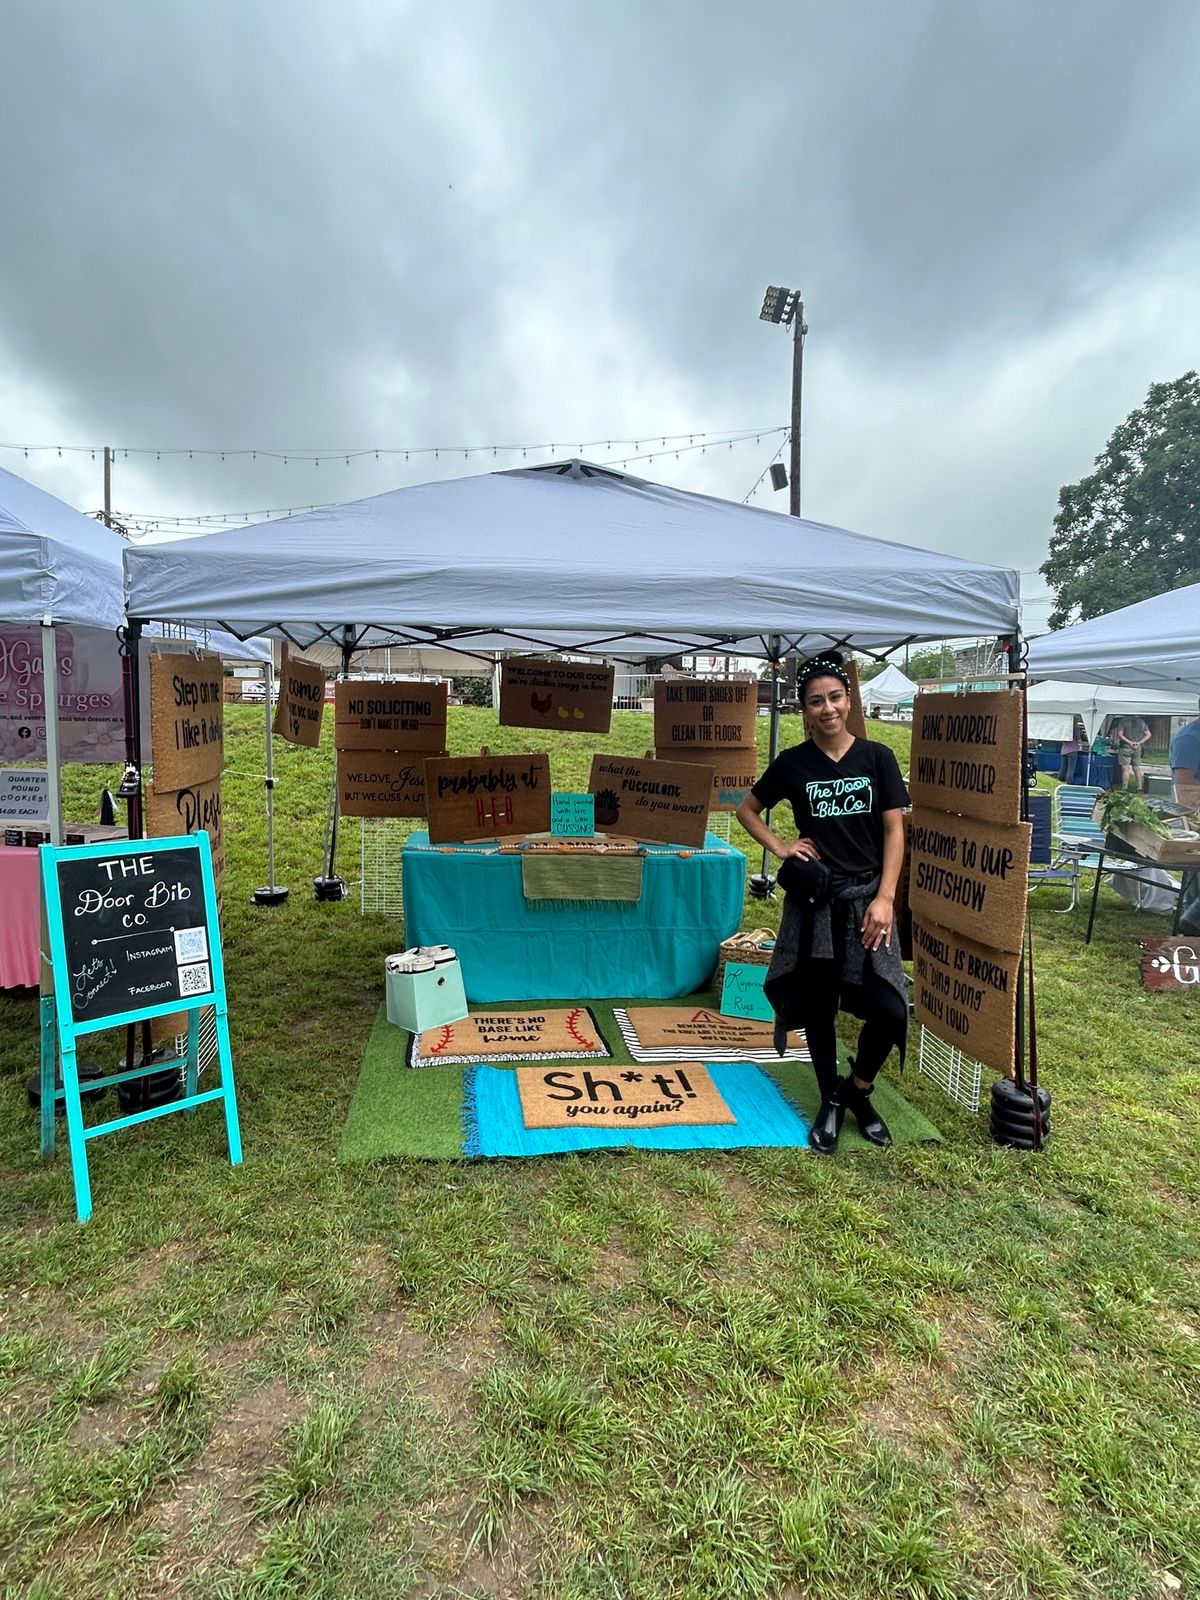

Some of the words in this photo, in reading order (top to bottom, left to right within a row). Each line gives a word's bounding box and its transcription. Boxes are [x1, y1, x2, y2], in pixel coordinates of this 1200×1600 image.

[507, 667, 552, 678] WELCOME
[554, 670, 565, 679] TO
[566, 670, 585, 680] OUR
[586, 672, 610, 681] COOP
[173, 675, 198, 712] Step
[200, 683, 209, 704] on
[210, 682, 220, 704] me
[666, 686, 684, 702] TAKE
[685, 686, 707, 703] YOUR
[709, 686, 733, 703] SHOES
[735, 687, 748, 703] OFF
[348, 700, 364, 715] NO
[367, 700, 432, 716] SOLICITING
[703, 705, 714, 721] OR
[377, 718, 392, 730] MAKE
[393, 718, 399, 730] IT
[672, 724, 696, 741] CLEAN
[698, 724, 712, 741] THE
[714, 725, 742, 742] FLOORS
[921, 714, 944, 741] RING
[945, 715, 998, 745] DOORBELL
[175, 719, 179, 750] I
[182, 719, 200, 749] like
[201, 719, 208, 746] it
[347, 773, 362, 783] WE
[364, 774, 391, 783] LOVE
[599, 763, 624, 775] what
[625, 765, 641, 777] the
[917, 757, 936, 785] WIN
[938, 760, 946, 788] A
[949, 760, 996, 794] TODDLER
[437, 767, 518, 799] probably
[520, 764, 543, 789] at
[720, 776, 737, 787] YOU
[738, 776, 756, 787] LIKE
[806, 783, 832, 801] The
[833, 779, 868, 796] Door
[0, 794, 47, 802] COOKIES!
[344, 792, 360, 801] BUT
[361, 792, 377, 801] WE
[378, 793, 400, 802] CUSS
[403, 793, 410, 802] A
[552, 796, 570, 805] Hand
[635, 797, 648, 808] do
[650, 800, 671, 813] you
[672, 802, 705, 814] want?
[817, 799, 843, 817] Bib
[844, 795, 868, 812] Co.
[476, 796, 513, 827] H-E-B
[962, 837, 976, 869] to
[98, 855, 155, 881] THE
[916, 862, 986, 912] SHITSHOW
[74, 887, 135, 916] Door
[144, 881, 191, 908] Bib
[126, 945, 173, 961] INSTAGRAM
[919, 927, 950, 966] DOORBELL
[954, 948, 965, 971] IS
[967, 954, 1009, 992] BROKEN
[72, 958, 117, 1009] Connect!
[734, 996, 754, 1015] Rugs
[473, 1017, 526, 1025] THERE'S
[478, 1025, 512, 1033] BASE
[483, 1034, 541, 1043] home
[566, 1103, 610, 1118] you
[613, 1100, 684, 1118] again?
